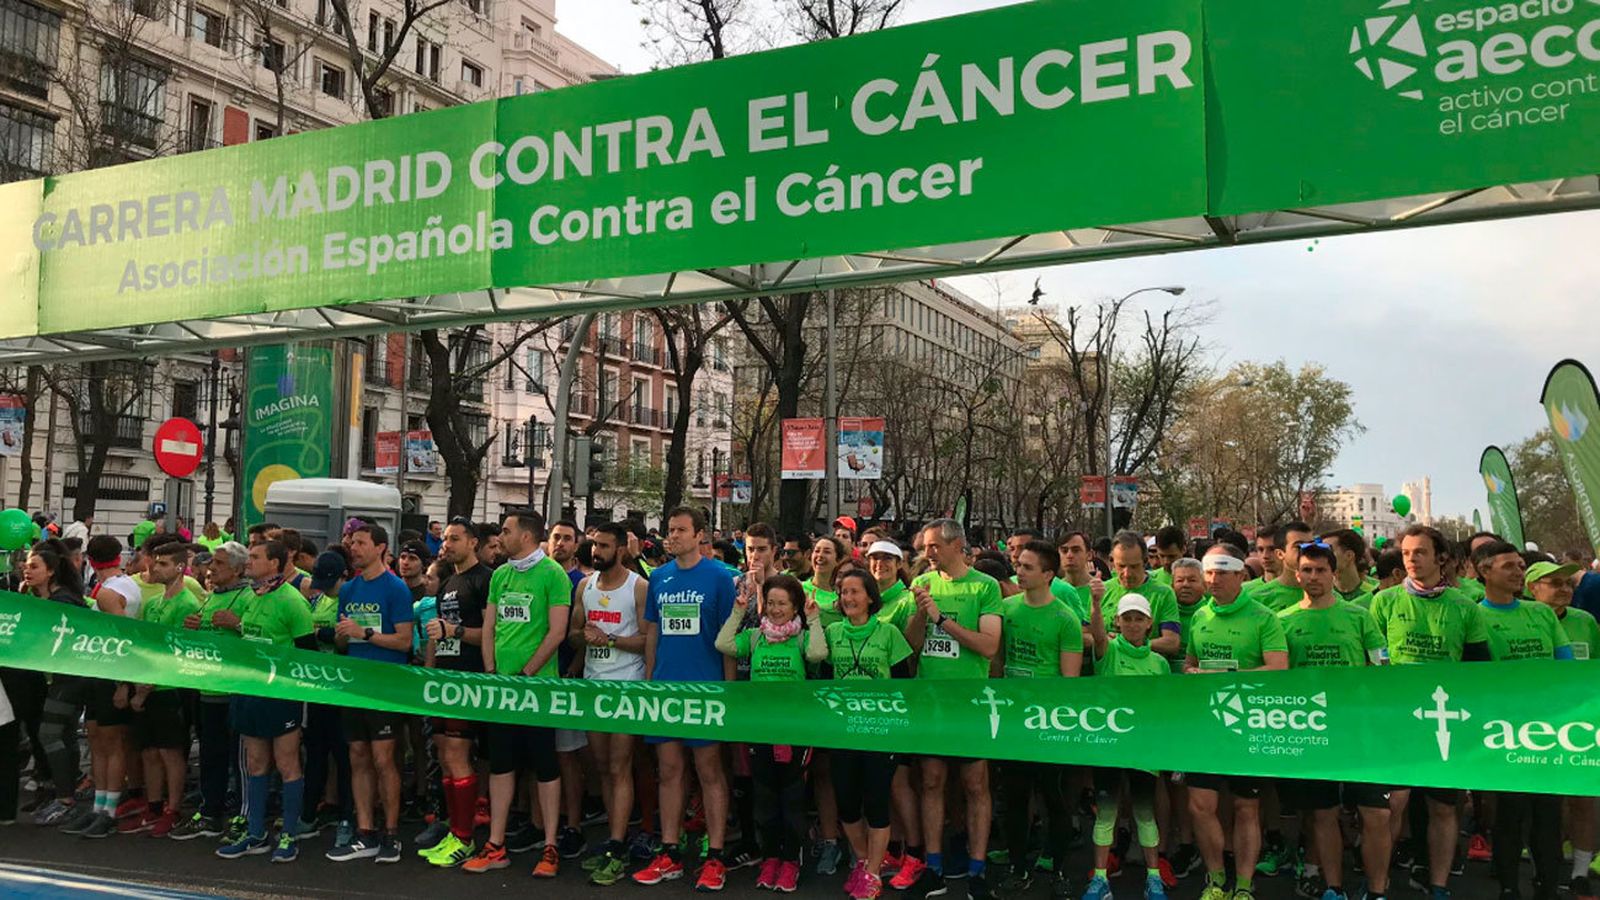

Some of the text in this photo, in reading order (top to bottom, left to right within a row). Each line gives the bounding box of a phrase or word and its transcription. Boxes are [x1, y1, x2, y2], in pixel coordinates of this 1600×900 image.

[1434, 0, 1574, 32] espacio
[1439, 85, 1523, 112] activo
[1439, 103, 1570, 134] el cáncer
[33, 30, 1194, 252] CARRERA MADRID CONTRA EL CÁNCER
[118, 157, 983, 295] Asociación Española Contra el Cáncer
[255, 394, 320, 420] IMAGINA
[345, 602, 380, 613] OCASO
[657, 589, 705, 604] MetLife
[503, 606, 524, 618] 9919
[669, 618, 692, 630] 8514
[72, 633, 133, 657] aecc
[185, 645, 222, 662] aecc
[289, 661, 354, 683] aecc
[423, 680, 726, 727] CONTRA EL CÁNCER
[846, 697, 908, 714] aecc
[1247, 695, 1308, 706] espacio
[1024, 704, 1135, 733] aecc
[1247, 708, 1328, 731] aecc
[1248, 734, 1329, 746] activo contra
[1483, 719, 1600, 752] aec
[1248, 744, 1304, 756] el cáncer
[1506, 752, 1547, 765] Contra
[1553, 754, 1564, 765] el
